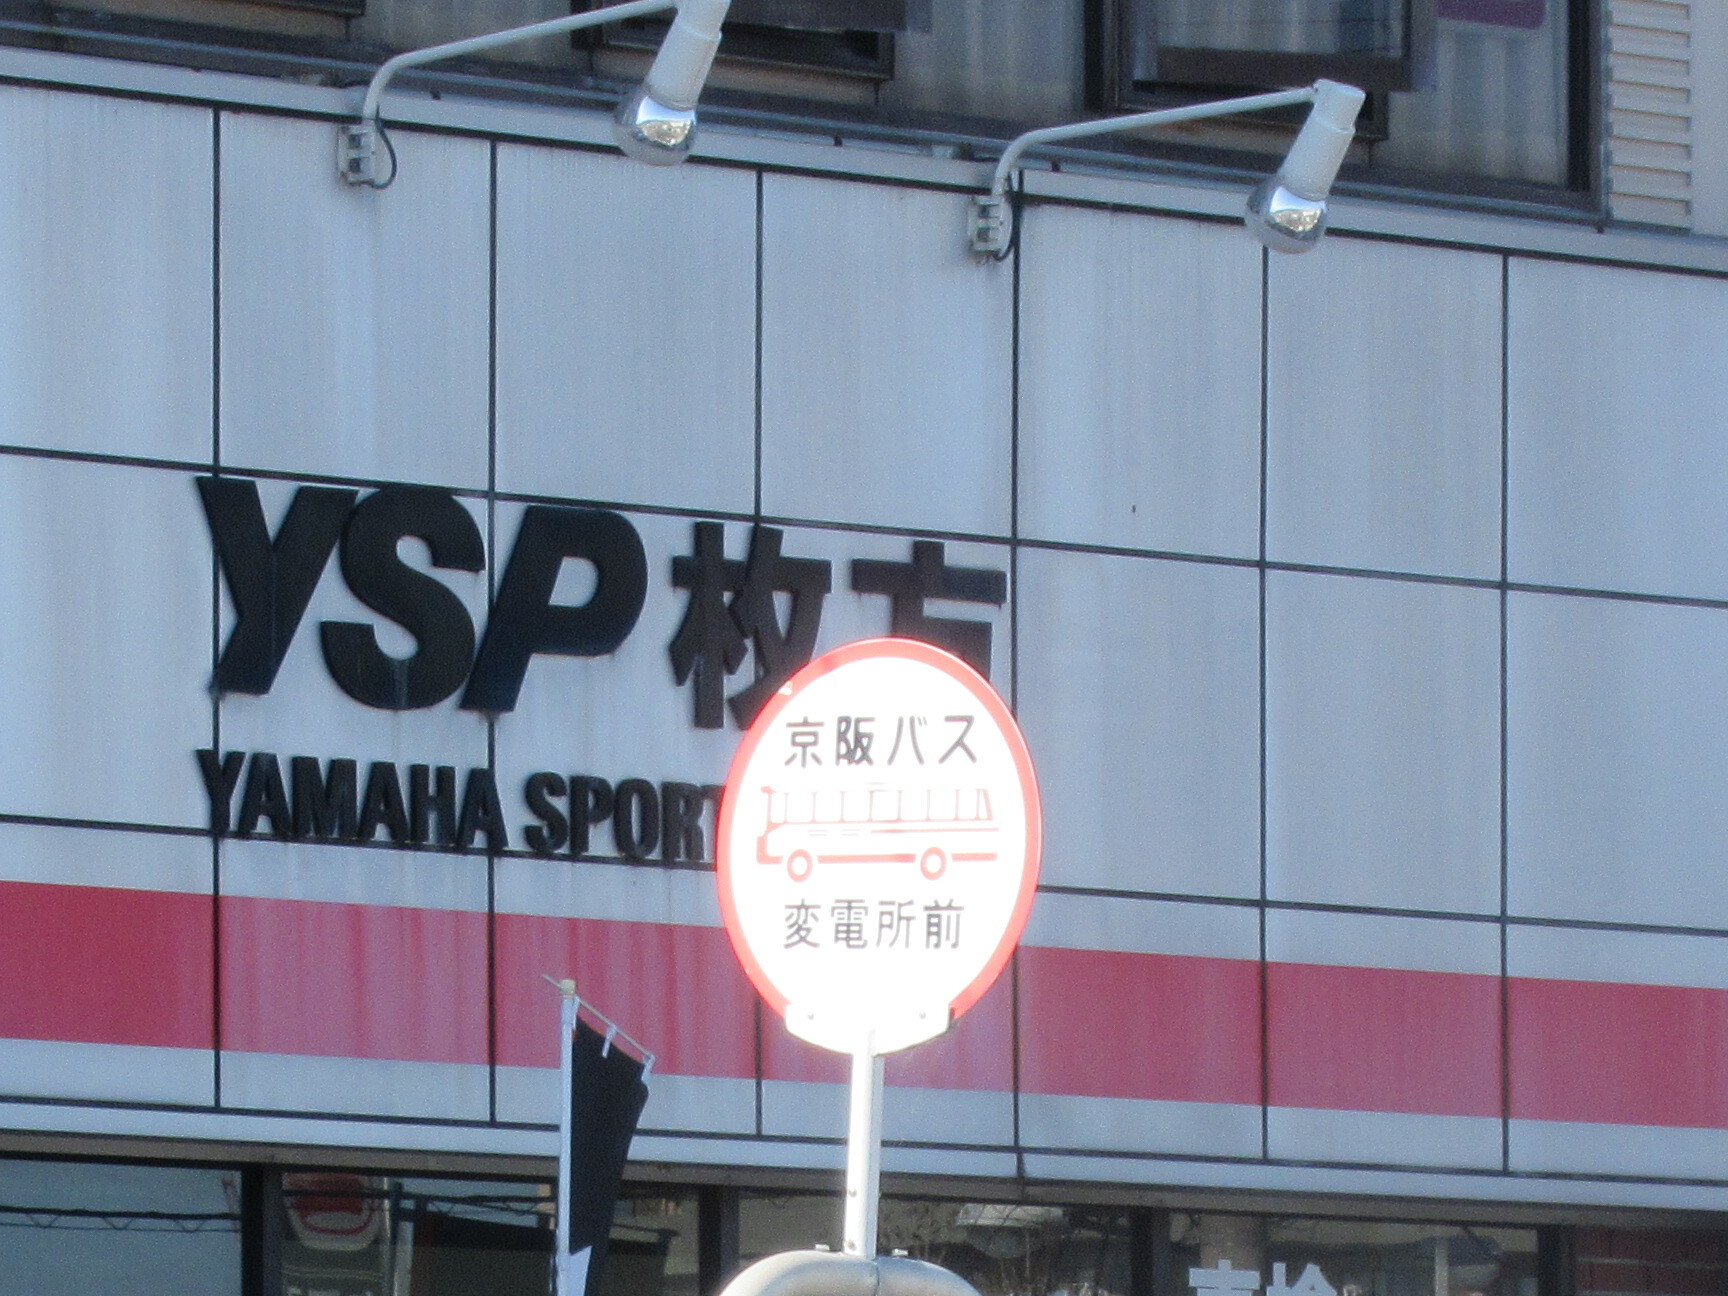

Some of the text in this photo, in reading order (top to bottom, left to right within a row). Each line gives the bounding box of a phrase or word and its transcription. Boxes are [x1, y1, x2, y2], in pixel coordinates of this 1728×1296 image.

[196, 474, 650, 714] YSP
[784, 714, 978, 768] 京阪バス
[196, 748, 722, 864] YAMAHA SPORT
[783, 898, 965, 949] 変電所前
